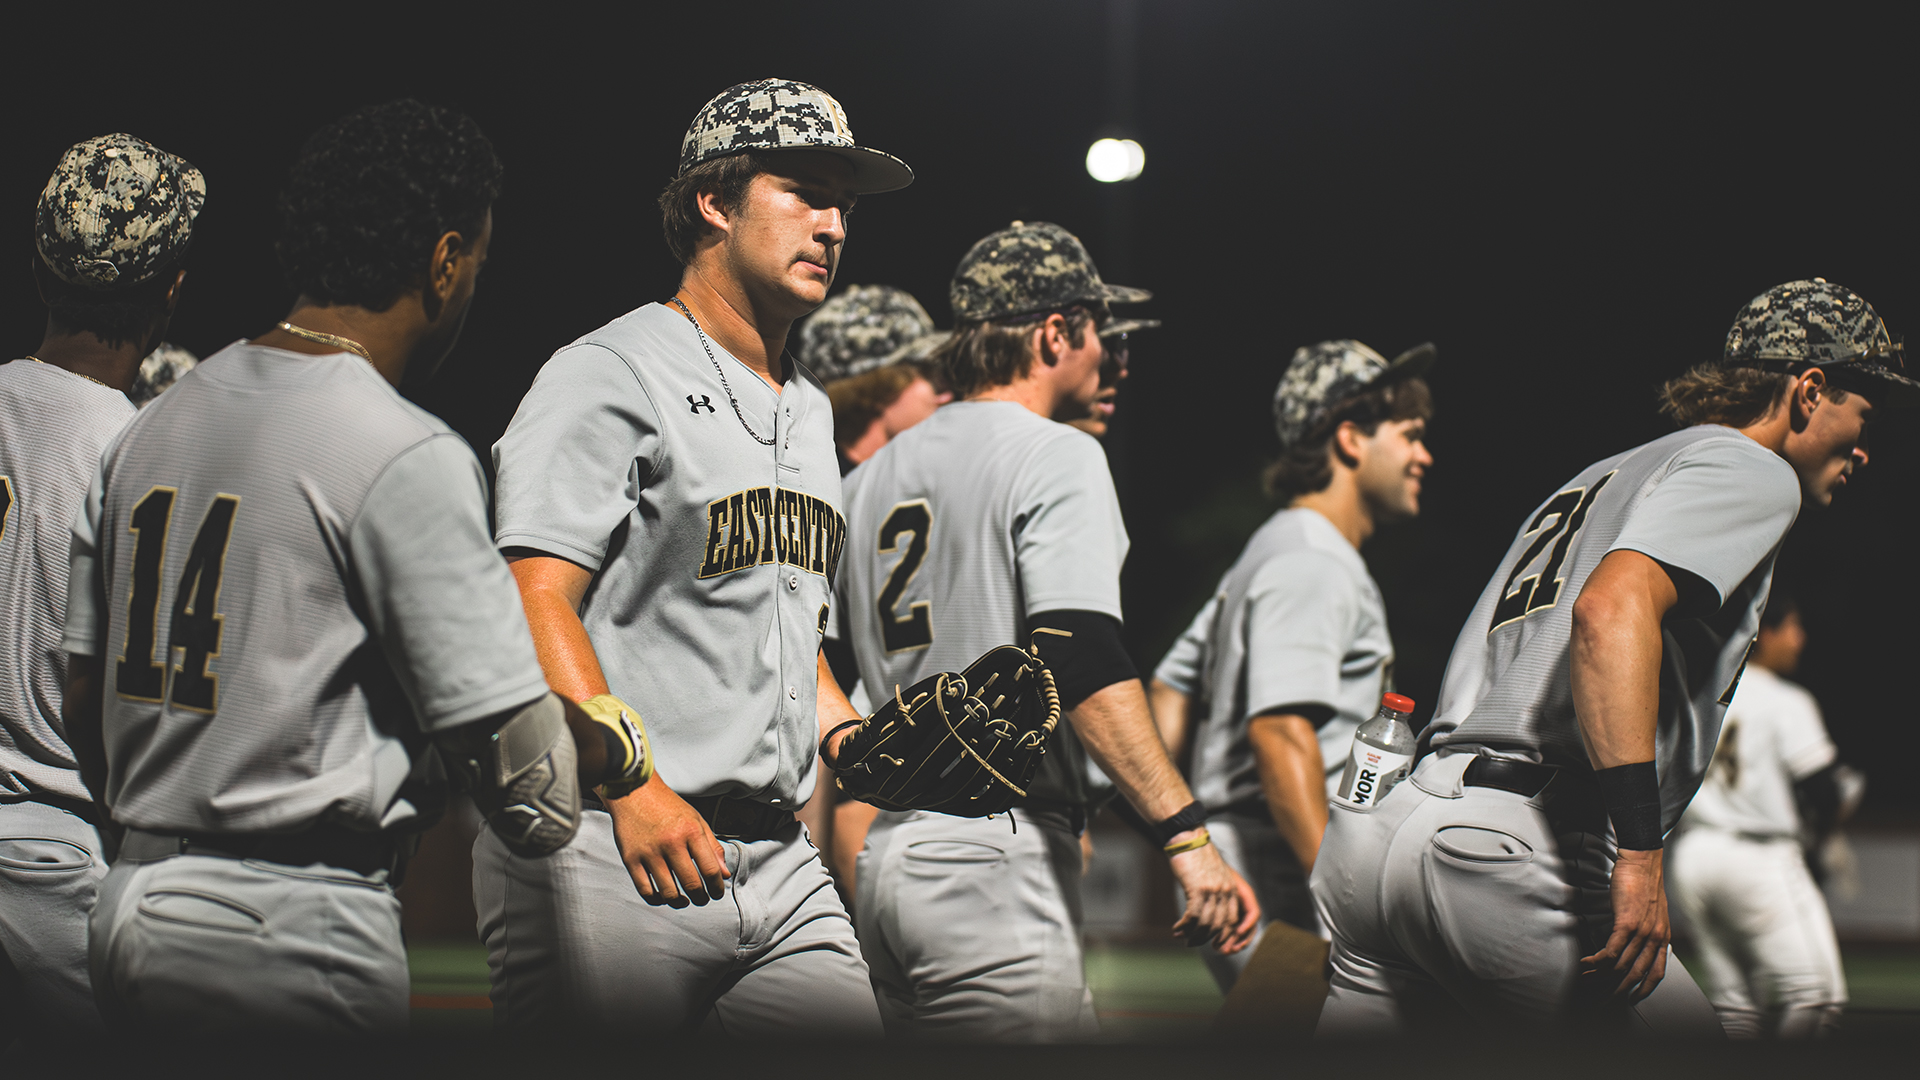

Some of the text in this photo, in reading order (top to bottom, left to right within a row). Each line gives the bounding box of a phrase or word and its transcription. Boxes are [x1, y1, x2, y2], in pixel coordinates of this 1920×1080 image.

[116, 484, 241, 714] 14
[877, 498, 934, 657] 2
[1488, 469, 1619, 635] 21
